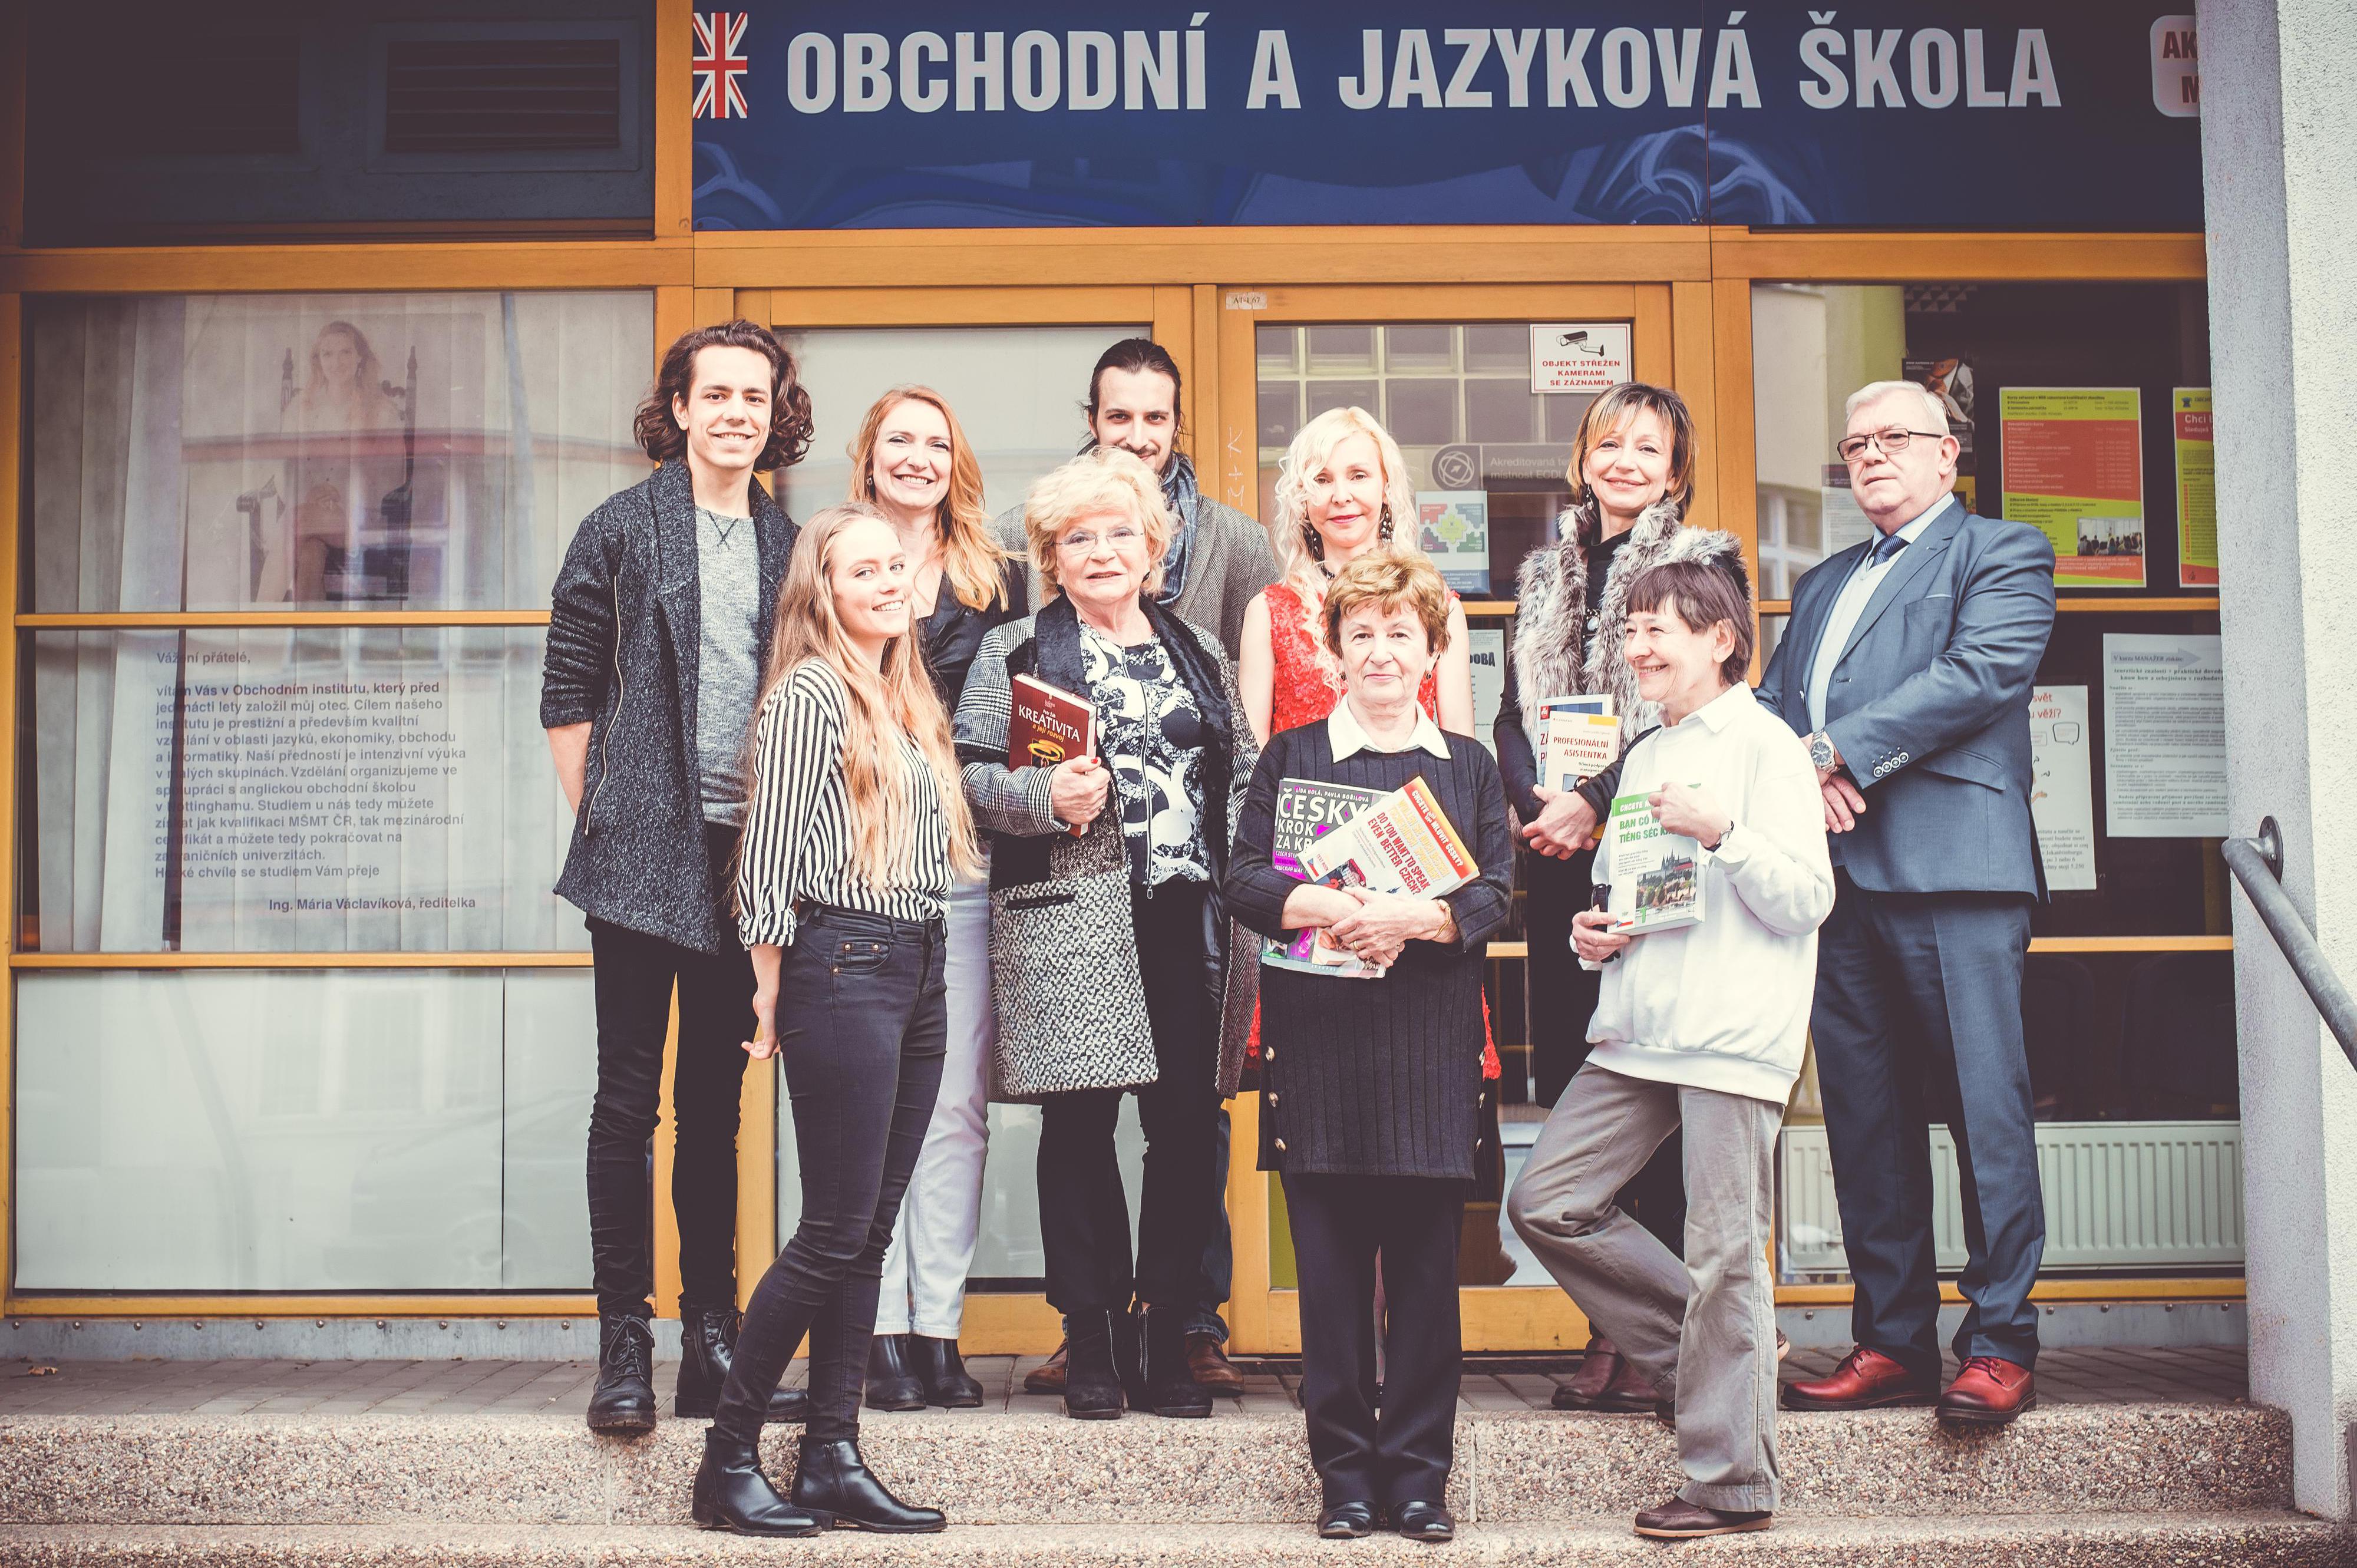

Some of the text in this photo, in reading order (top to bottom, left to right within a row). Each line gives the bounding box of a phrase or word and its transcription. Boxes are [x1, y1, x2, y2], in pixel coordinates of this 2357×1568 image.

[787, 9, 2062, 114] OBCHODNÍ A JAZYKOVÁ ŠKOLA
[1580, 358, 1620, 367] STŘEŽEN
[1563, 378, 1614, 387] ZÁZNAMEM
[1490, 457, 1556, 467] Akreditovaná
[156, 651, 251, 666] Vážní přátelé,
[194, 684, 217, 696] Vás
[221, 687, 229, 695] v
[233, 683, 308, 696] Obchodním
[312, 683, 369, 696] institutu,
[373, 682, 406, 695] který
[410, 682, 440, 696] před
[156, 698, 443, 715] jednácti lety založil můj otec. Cílem našeho
[156, 715, 419, 731] instutu je prestižní a především kvalitní
[1018, 704, 1081, 743] KREATIVITA
[156, 731, 456, 747] vzlání v oblasti jazyků, ekonomiky, obchodu
[1047, 729, 1065, 743] rozvoj
[1553, 736, 1609, 748] PROFESIONÁLNÍ
[156, 747, 467, 764] a iormatiky. Naší předností je intenzivní výuka
[1564, 749, 1607, 760] ASISTENTKA
[156, 770, 163, 778] v
[217, 767, 288, 780] skupinách.
[291, 765, 346, 778] Vzdělání
[350, 765, 438, 778] organizujeme
[442, 766, 457, 775] ve
[156, 781, 416, 798] spupráci s anglickou obchodní školou
[156, 803, 163, 812] v
[258, 800, 312, 811] Studiem
[316, 801, 324, 810] u
[328, 799, 351, 810] nás
[355, 798, 383, 812] tedy
[387, 798, 434, 809] můžete
[1620, 801, 1643, 813] CHCETE
[196, 817, 216, 831] jak
[220, 816, 285, 828] kvalifikaci
[288, 814, 329, 827] MŠMT
[333, 813, 356, 827] ČR,
[360, 815, 379, 826] tak
[384, 814, 464, 826] mezinárodní
[1277, 818, 1316, 837] KROK
[1638, 814, 1650, 826] CÓ
[1411, 790, 1464, 867] CHCETE MLUVIT ČESKY?
[155, 831, 402, 846] cefikát a můžete tedy pokračovat na
[1275, 834, 1291, 850] ZA
[155, 849, 325, 861] zaaničních univerzitách.
[1367, 817, 1385, 839] EVEN
[1379, 837, 1404, 867] BETTER
[1398, 866, 1422, 896] CZECH?
[1376, 811, 1431, 890] DO YOU WANT TO SPEAK
[198, 866, 237, 877] chvíle
[240, 869, 256, 877] se
[259, 866, 312, 877] studiem
[315, 865, 343, 877] Vám
[347, 865, 380, 879] přeje
[269, 897, 476, 913] Ing. Mária Václavíková, ředitelka
